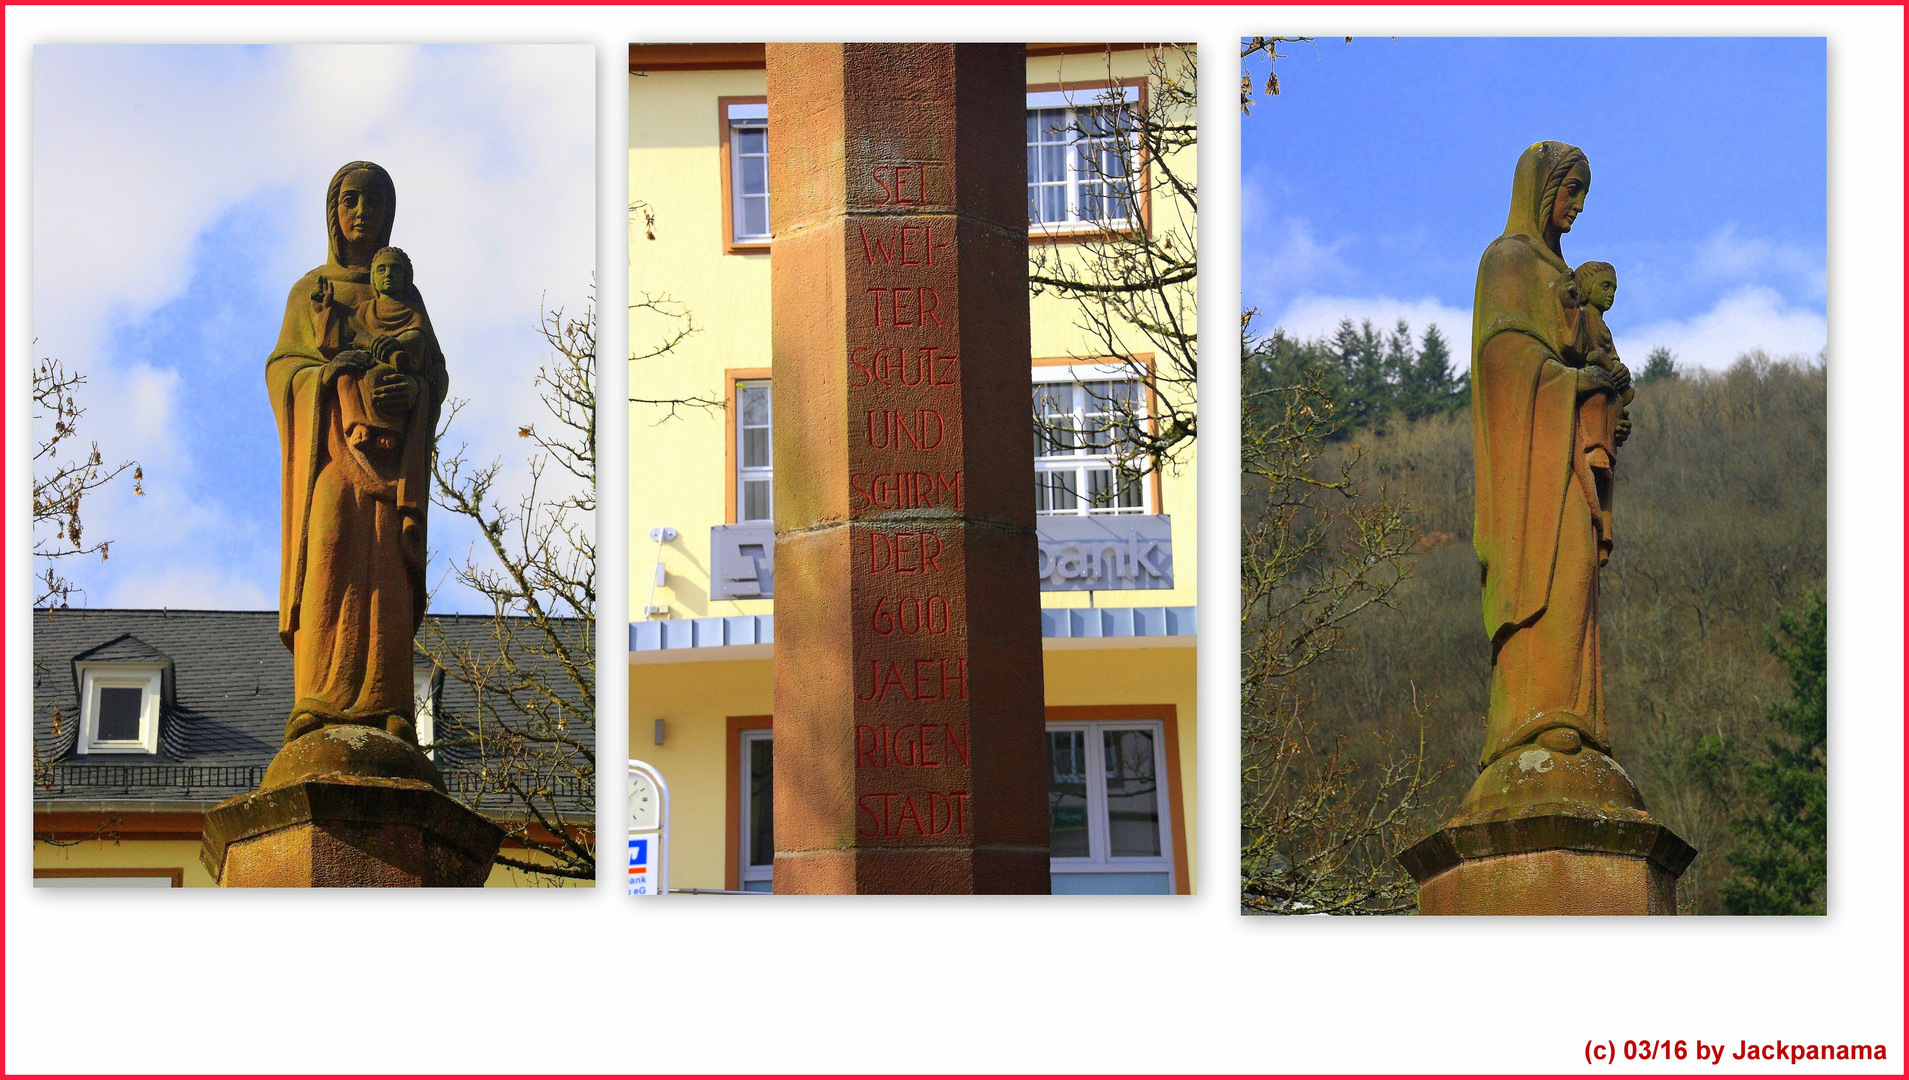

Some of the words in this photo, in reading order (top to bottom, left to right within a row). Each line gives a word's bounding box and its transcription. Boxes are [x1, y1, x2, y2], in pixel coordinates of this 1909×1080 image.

[872, 166, 928, 206] SEI
[859, 226, 948, 266] WEI-
[866, 287, 943, 327] TER
[851, 347, 960, 388] SCHUTZ
[868, 409, 945, 451] UND
[850, 471, 961, 512] SCHIRM
[870, 532, 943, 574] DER
[872, 595, 950, 636] 600
[858, 658, 968, 703] JAEH
[856, 722, 970, 770] RIGEN
[858, 791, 971, 838] STADT
[628, 876, 646, 884] ank
